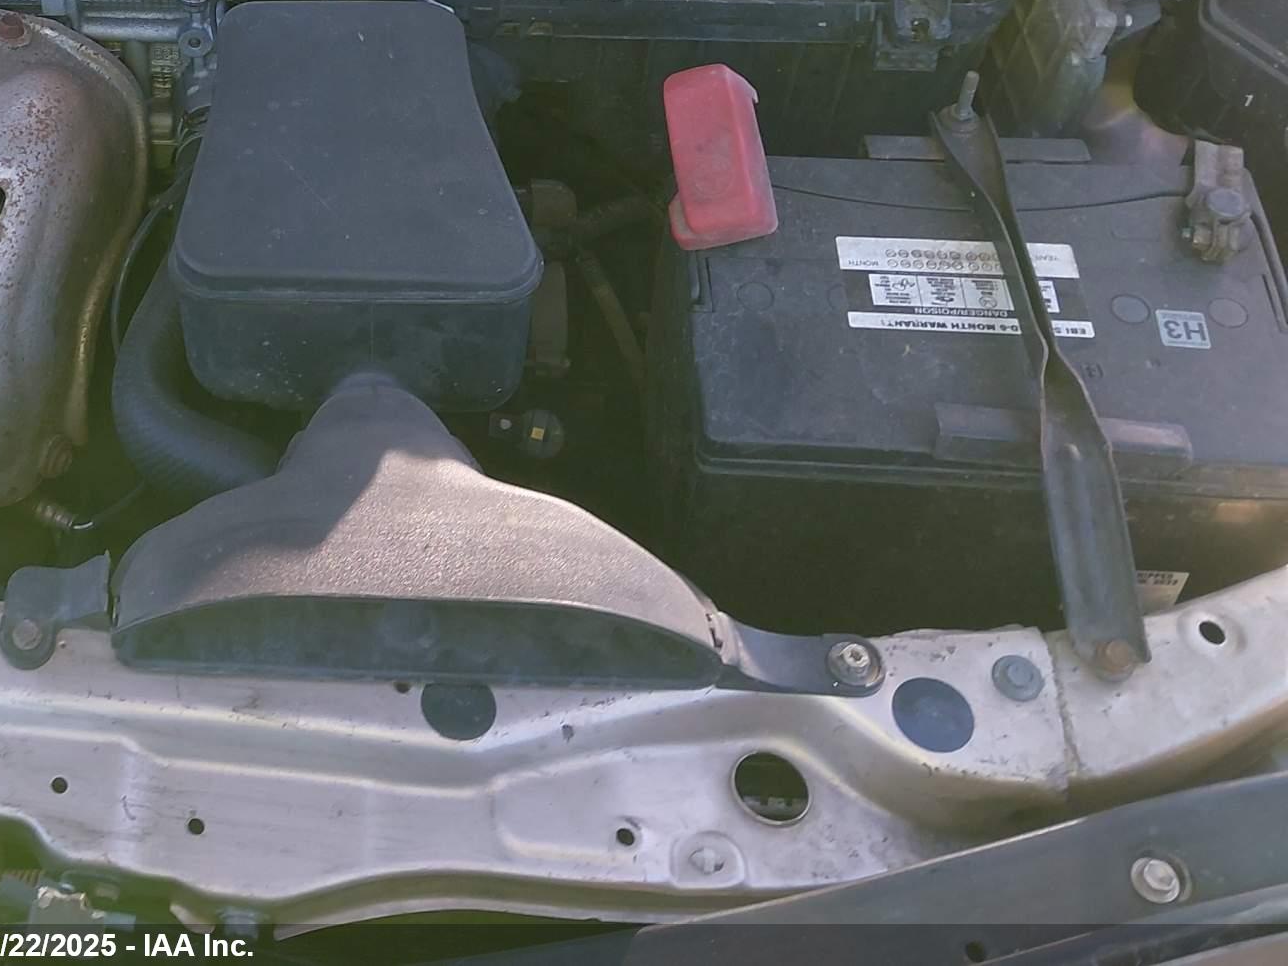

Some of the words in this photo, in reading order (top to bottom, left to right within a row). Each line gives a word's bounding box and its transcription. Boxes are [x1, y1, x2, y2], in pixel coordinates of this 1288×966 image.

[848, 259, 880, 267] MONTH
[913, 307, 1009, 318] DANGER/POISON
[951, 322, 996, 331] MONTH
[1162, 320, 1208, 342] H3
